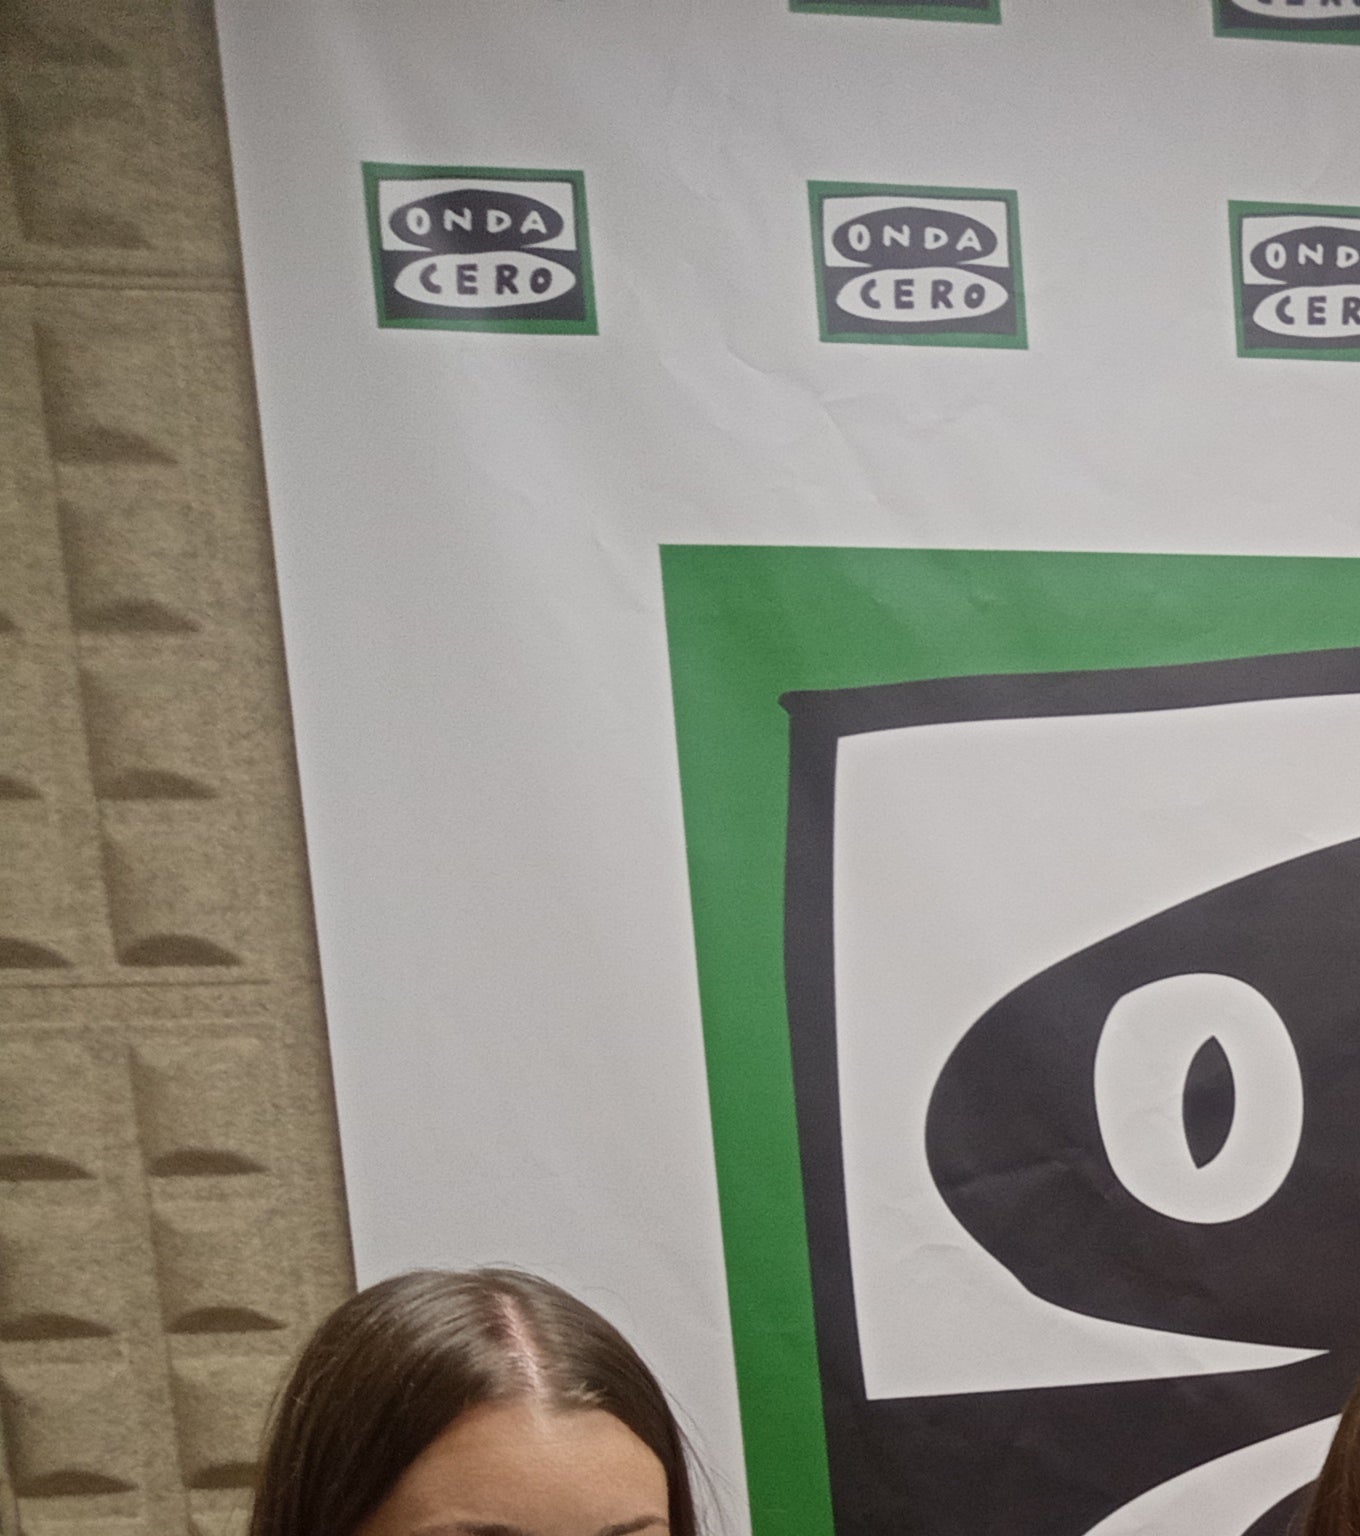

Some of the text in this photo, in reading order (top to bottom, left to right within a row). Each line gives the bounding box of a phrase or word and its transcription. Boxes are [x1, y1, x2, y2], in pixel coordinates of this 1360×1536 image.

[405, 206, 548, 236] ONDA
[848, 223, 982, 252] ONDA
[419, 263, 554, 296] CERO
[859, 278, 986, 310] CERO
